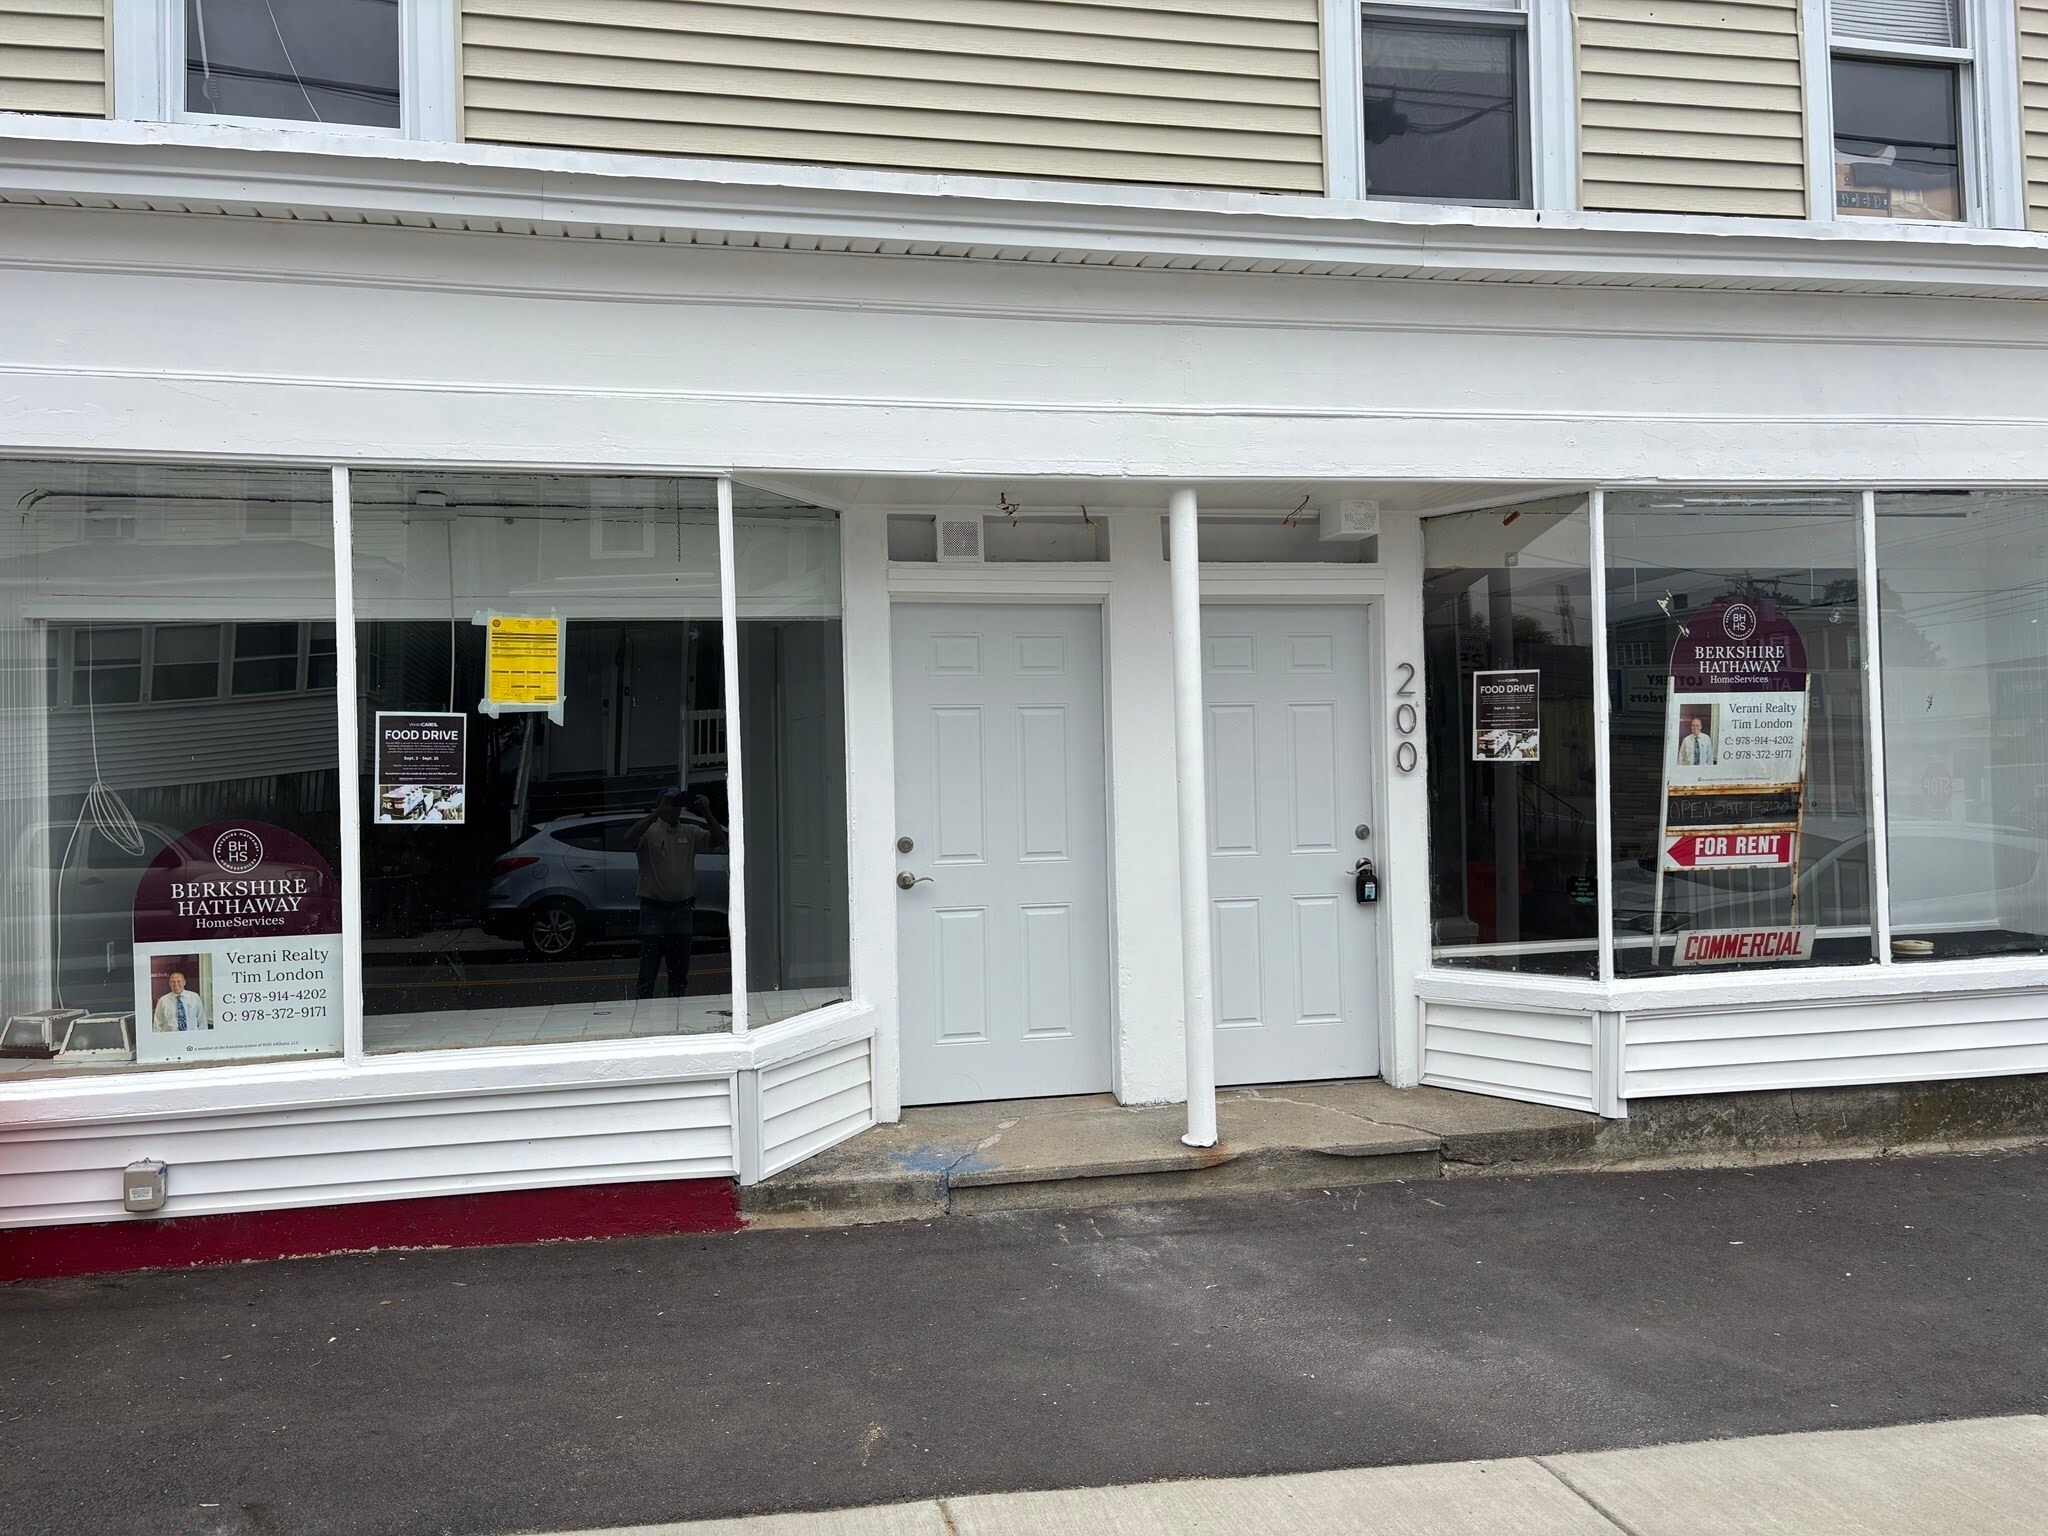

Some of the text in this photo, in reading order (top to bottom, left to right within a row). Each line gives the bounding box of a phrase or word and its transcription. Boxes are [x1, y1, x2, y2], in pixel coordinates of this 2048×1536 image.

[1733, 613, 1746, 622] BH
[1733, 622, 1746, 631] HS
[1695, 646, 1785, 659] BERKSHIRE
[1700, 660, 1781, 673] HATHAWAY
[1710, 675, 1768, 684] HomeServices
[1480, 684, 1535, 694] FOOD DRIVE
[1729, 703, 1762, 714] Verani
[1765, 702, 1797, 716] Realty
[1396, 663, 1417, 772] 200
[1732, 719, 1793, 729] Tim London
[385, 729, 459, 740] FOOD DRIVE
[1724, 736, 1793, 746] C: 978-914-4202
[1723, 750, 1792, 760] O: 978-372-9171
[228, 841, 248, 852] BH
[1695, 835, 1781, 855] FOR RENT
[228, 851, 248, 862] HS
[170, 879, 307, 899] BERKSHIRE
[178, 896, 303, 917] HATHAWAY
[196, 916, 285, 929] HomeServices
[1684, 932, 1803, 961] COMMERCIAL
[226, 948, 329, 964] Verani Realty
[232, 968, 324, 984] Tim London
[222, 988, 327, 1005] C: 978-914-4202
[222, 1006, 327, 1023] O: 978-372-9171
